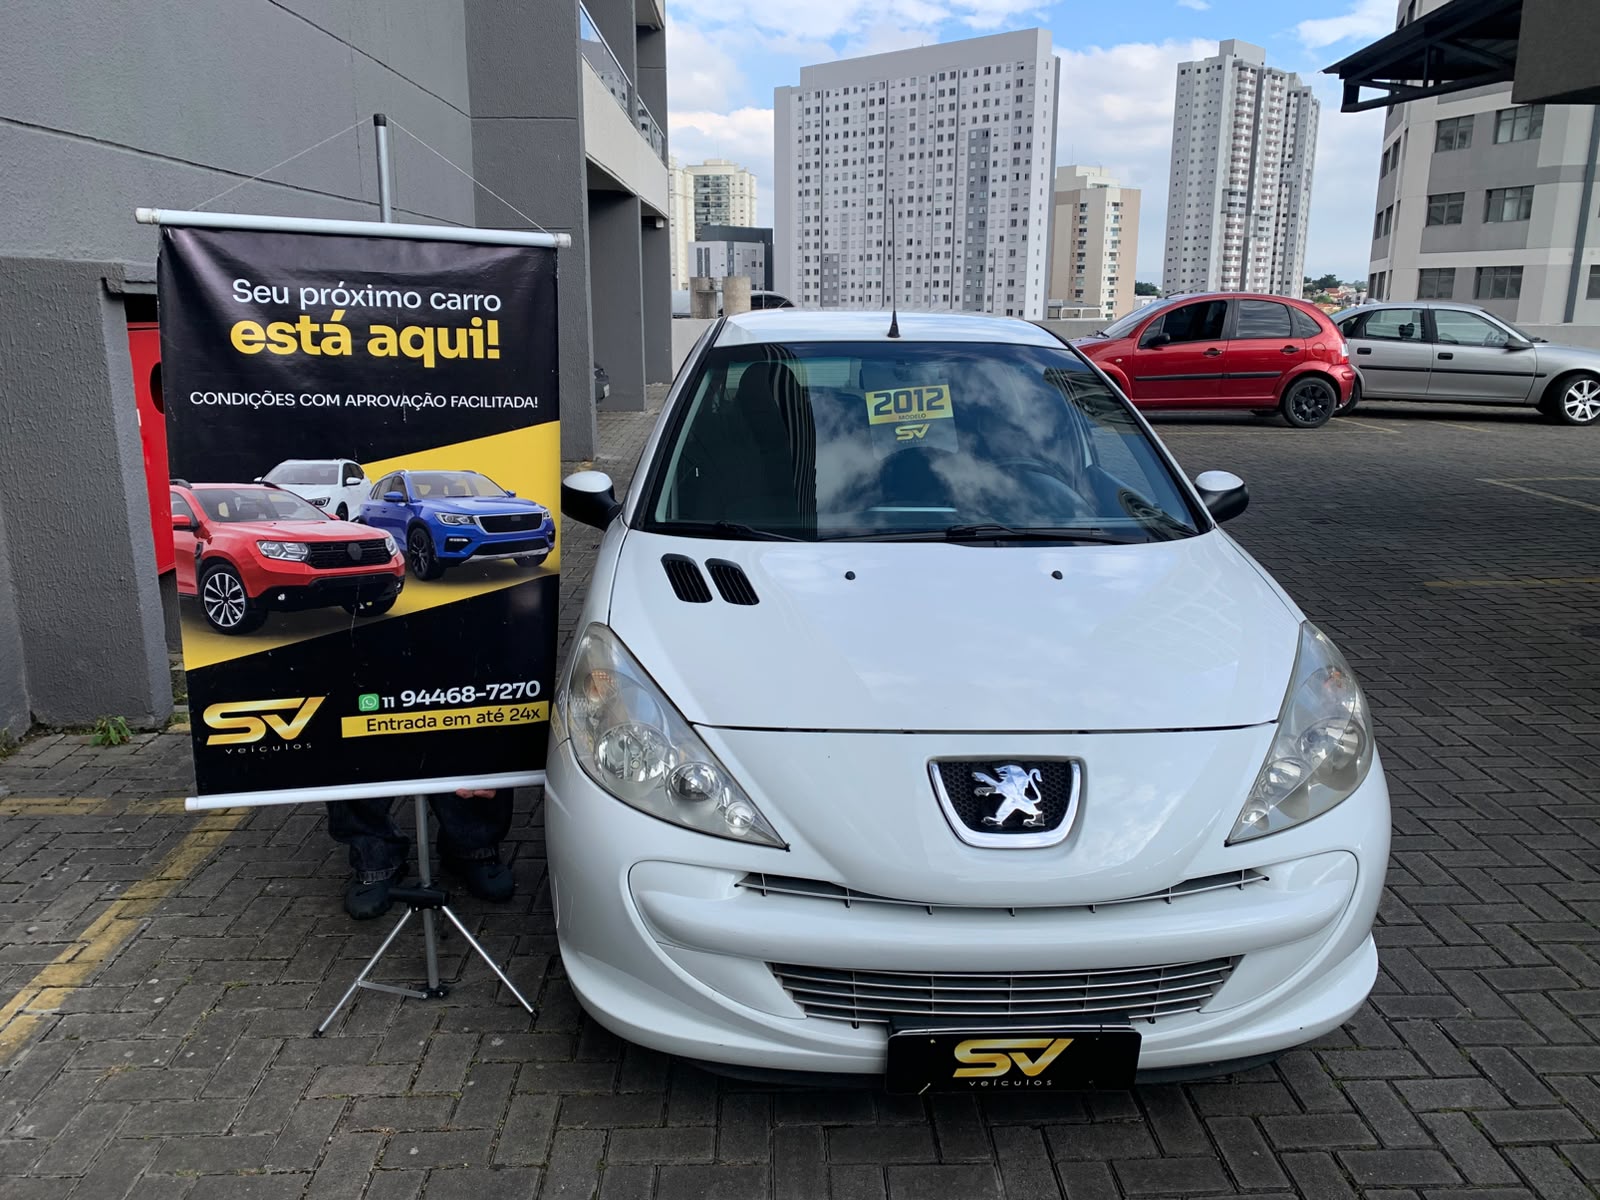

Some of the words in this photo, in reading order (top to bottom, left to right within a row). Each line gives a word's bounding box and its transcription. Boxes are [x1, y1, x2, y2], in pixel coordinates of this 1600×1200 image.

[232, 278, 290, 305] Seu
[300, 280, 422, 311] próximo
[429, 290, 502, 312] carro
[229, 309, 352, 356] está
[366, 317, 501, 368] aqui!
[189, 390, 296, 410] CONDIÇÕES
[299, 393, 341, 407] COM
[344, 392, 447, 412] APROVAÇÃO
[450, 395, 539, 409] FACILITADA!
[873, 387, 945, 416] 2012
[894, 423, 931, 440] SV
[381, 696, 396, 709] 11
[400, 680, 541, 708] 94468-7270
[202, 696, 327, 746] SV
[366, 714, 437, 732] Entrada
[442, 714, 471, 727] em
[476, 707, 505, 723] até
[509, 707, 541, 722] 24x
[952, 1038, 1075, 1078] SV
[968, 1078, 1053, 1087] veículos
